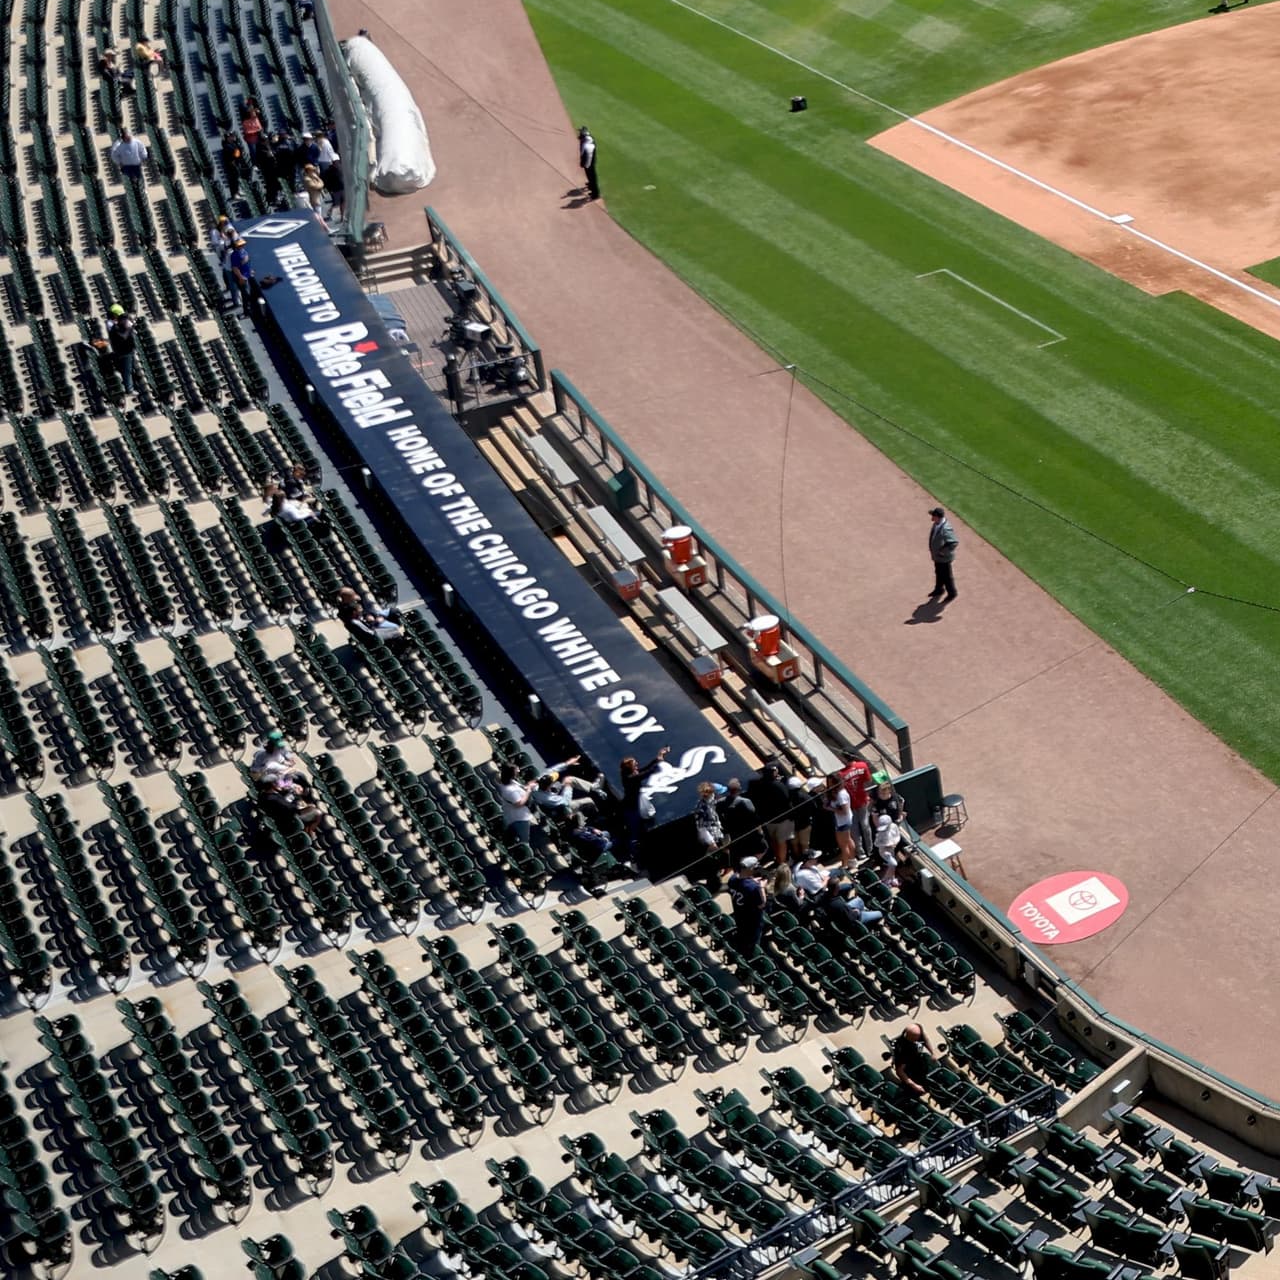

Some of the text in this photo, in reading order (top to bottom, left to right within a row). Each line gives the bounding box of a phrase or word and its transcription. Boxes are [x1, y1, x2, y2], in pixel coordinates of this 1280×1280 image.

[273, 242, 341, 323] WELCOME TO
[302, 321, 414, 429] Rate Field
[386, 424, 665, 743] HOME OF THE CHICAGO WHITE SOX
[1018, 901, 1061, 941] TOYOTA
